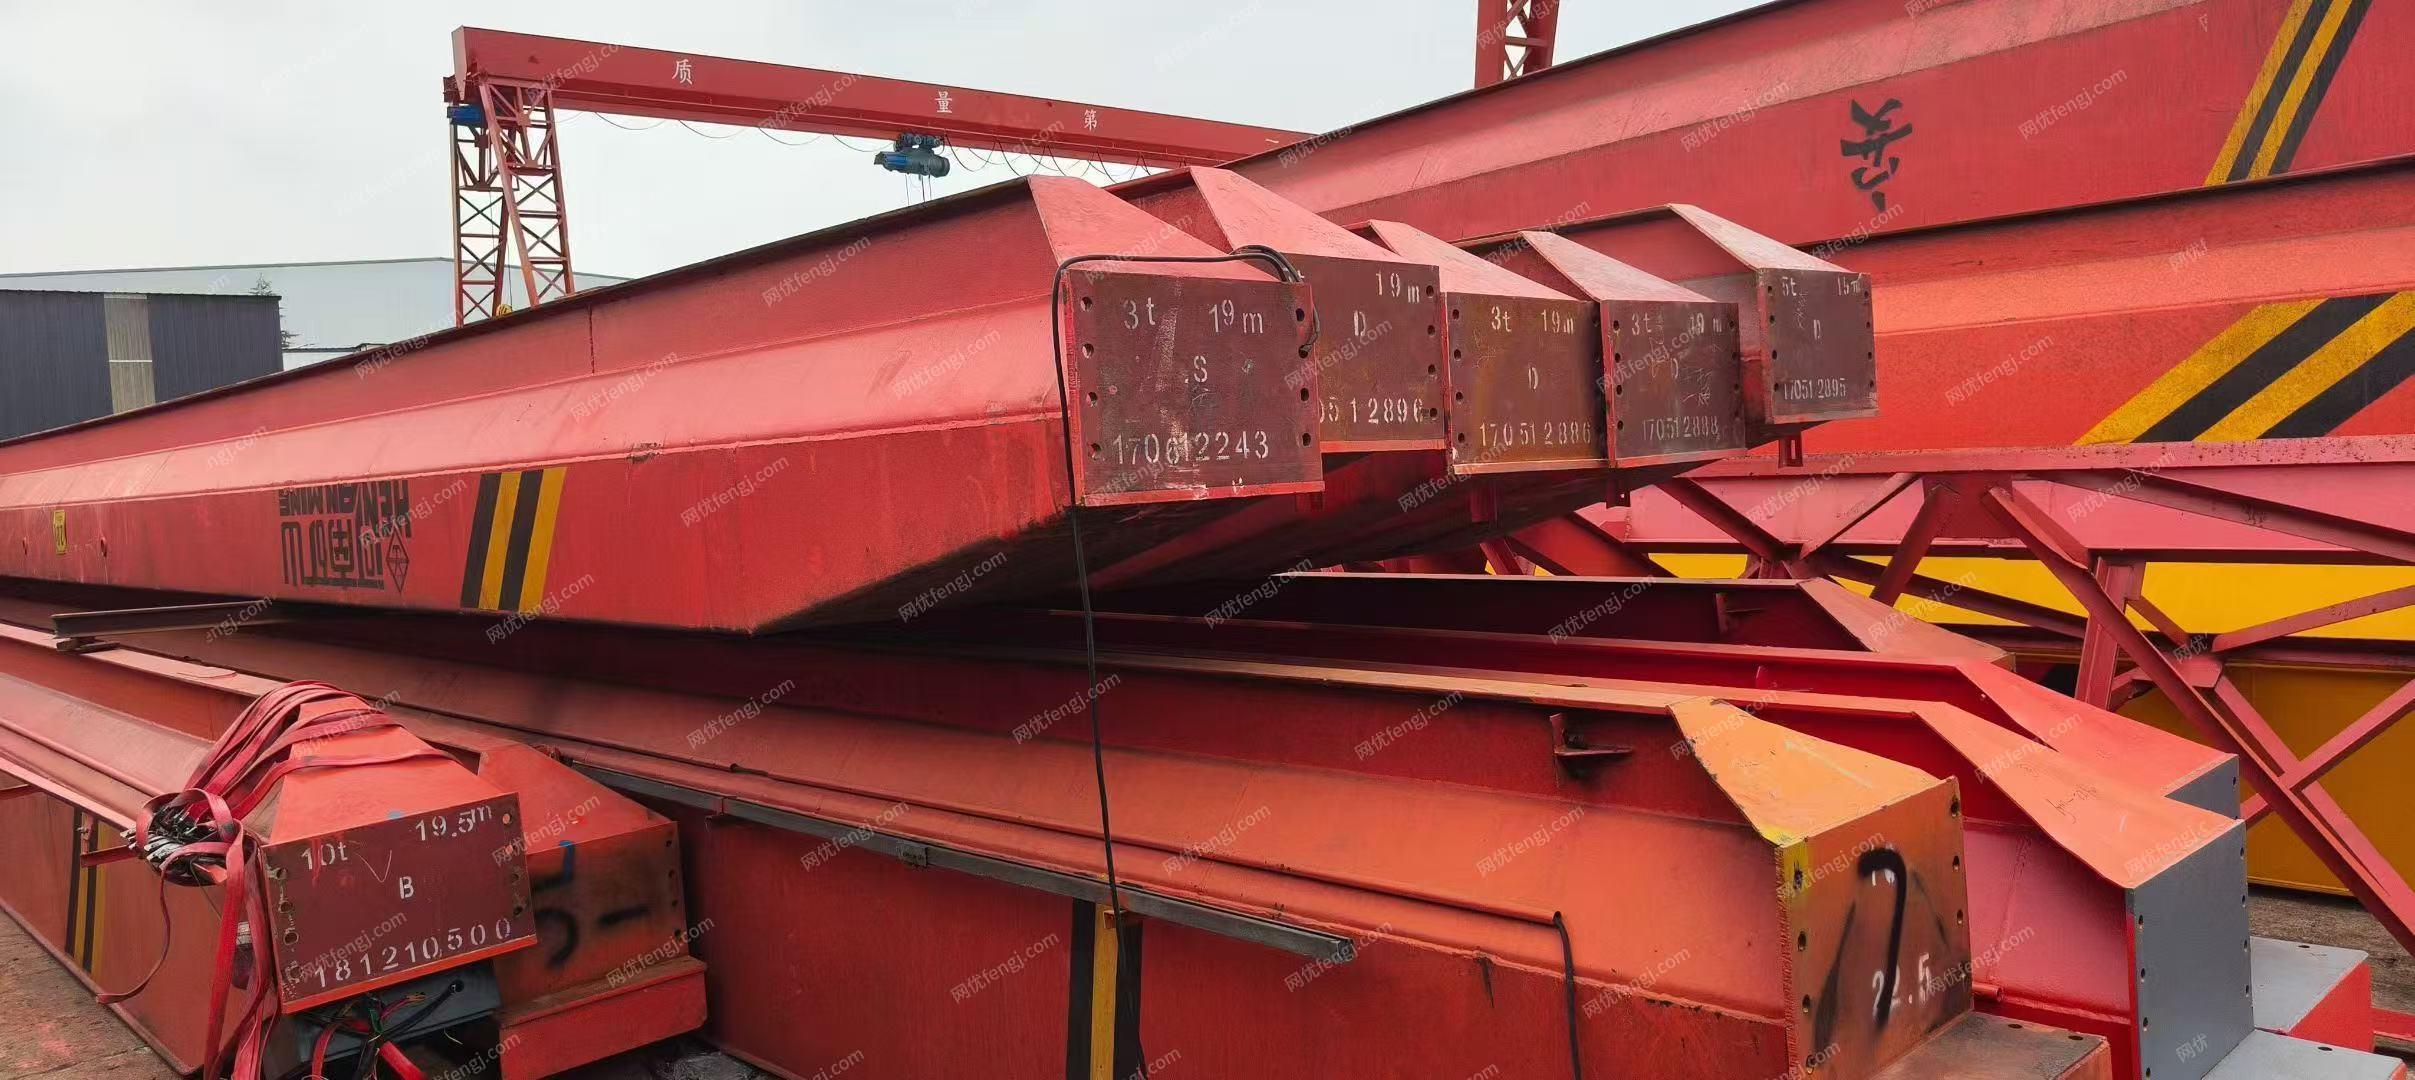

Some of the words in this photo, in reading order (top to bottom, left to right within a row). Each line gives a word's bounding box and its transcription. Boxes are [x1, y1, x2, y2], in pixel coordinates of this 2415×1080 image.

[671, 58, 693, 85] 质
[934, 91, 953, 114] 量
[1083, 109, 1098, 131] 第
[1491, 306, 1512, 333] 3t
[1112, 430, 1269, 465] 170612243
[301, 840, 348, 870] 10t
[399, 875, 415, 900] B
[314, 917, 512, 988] 181210500
